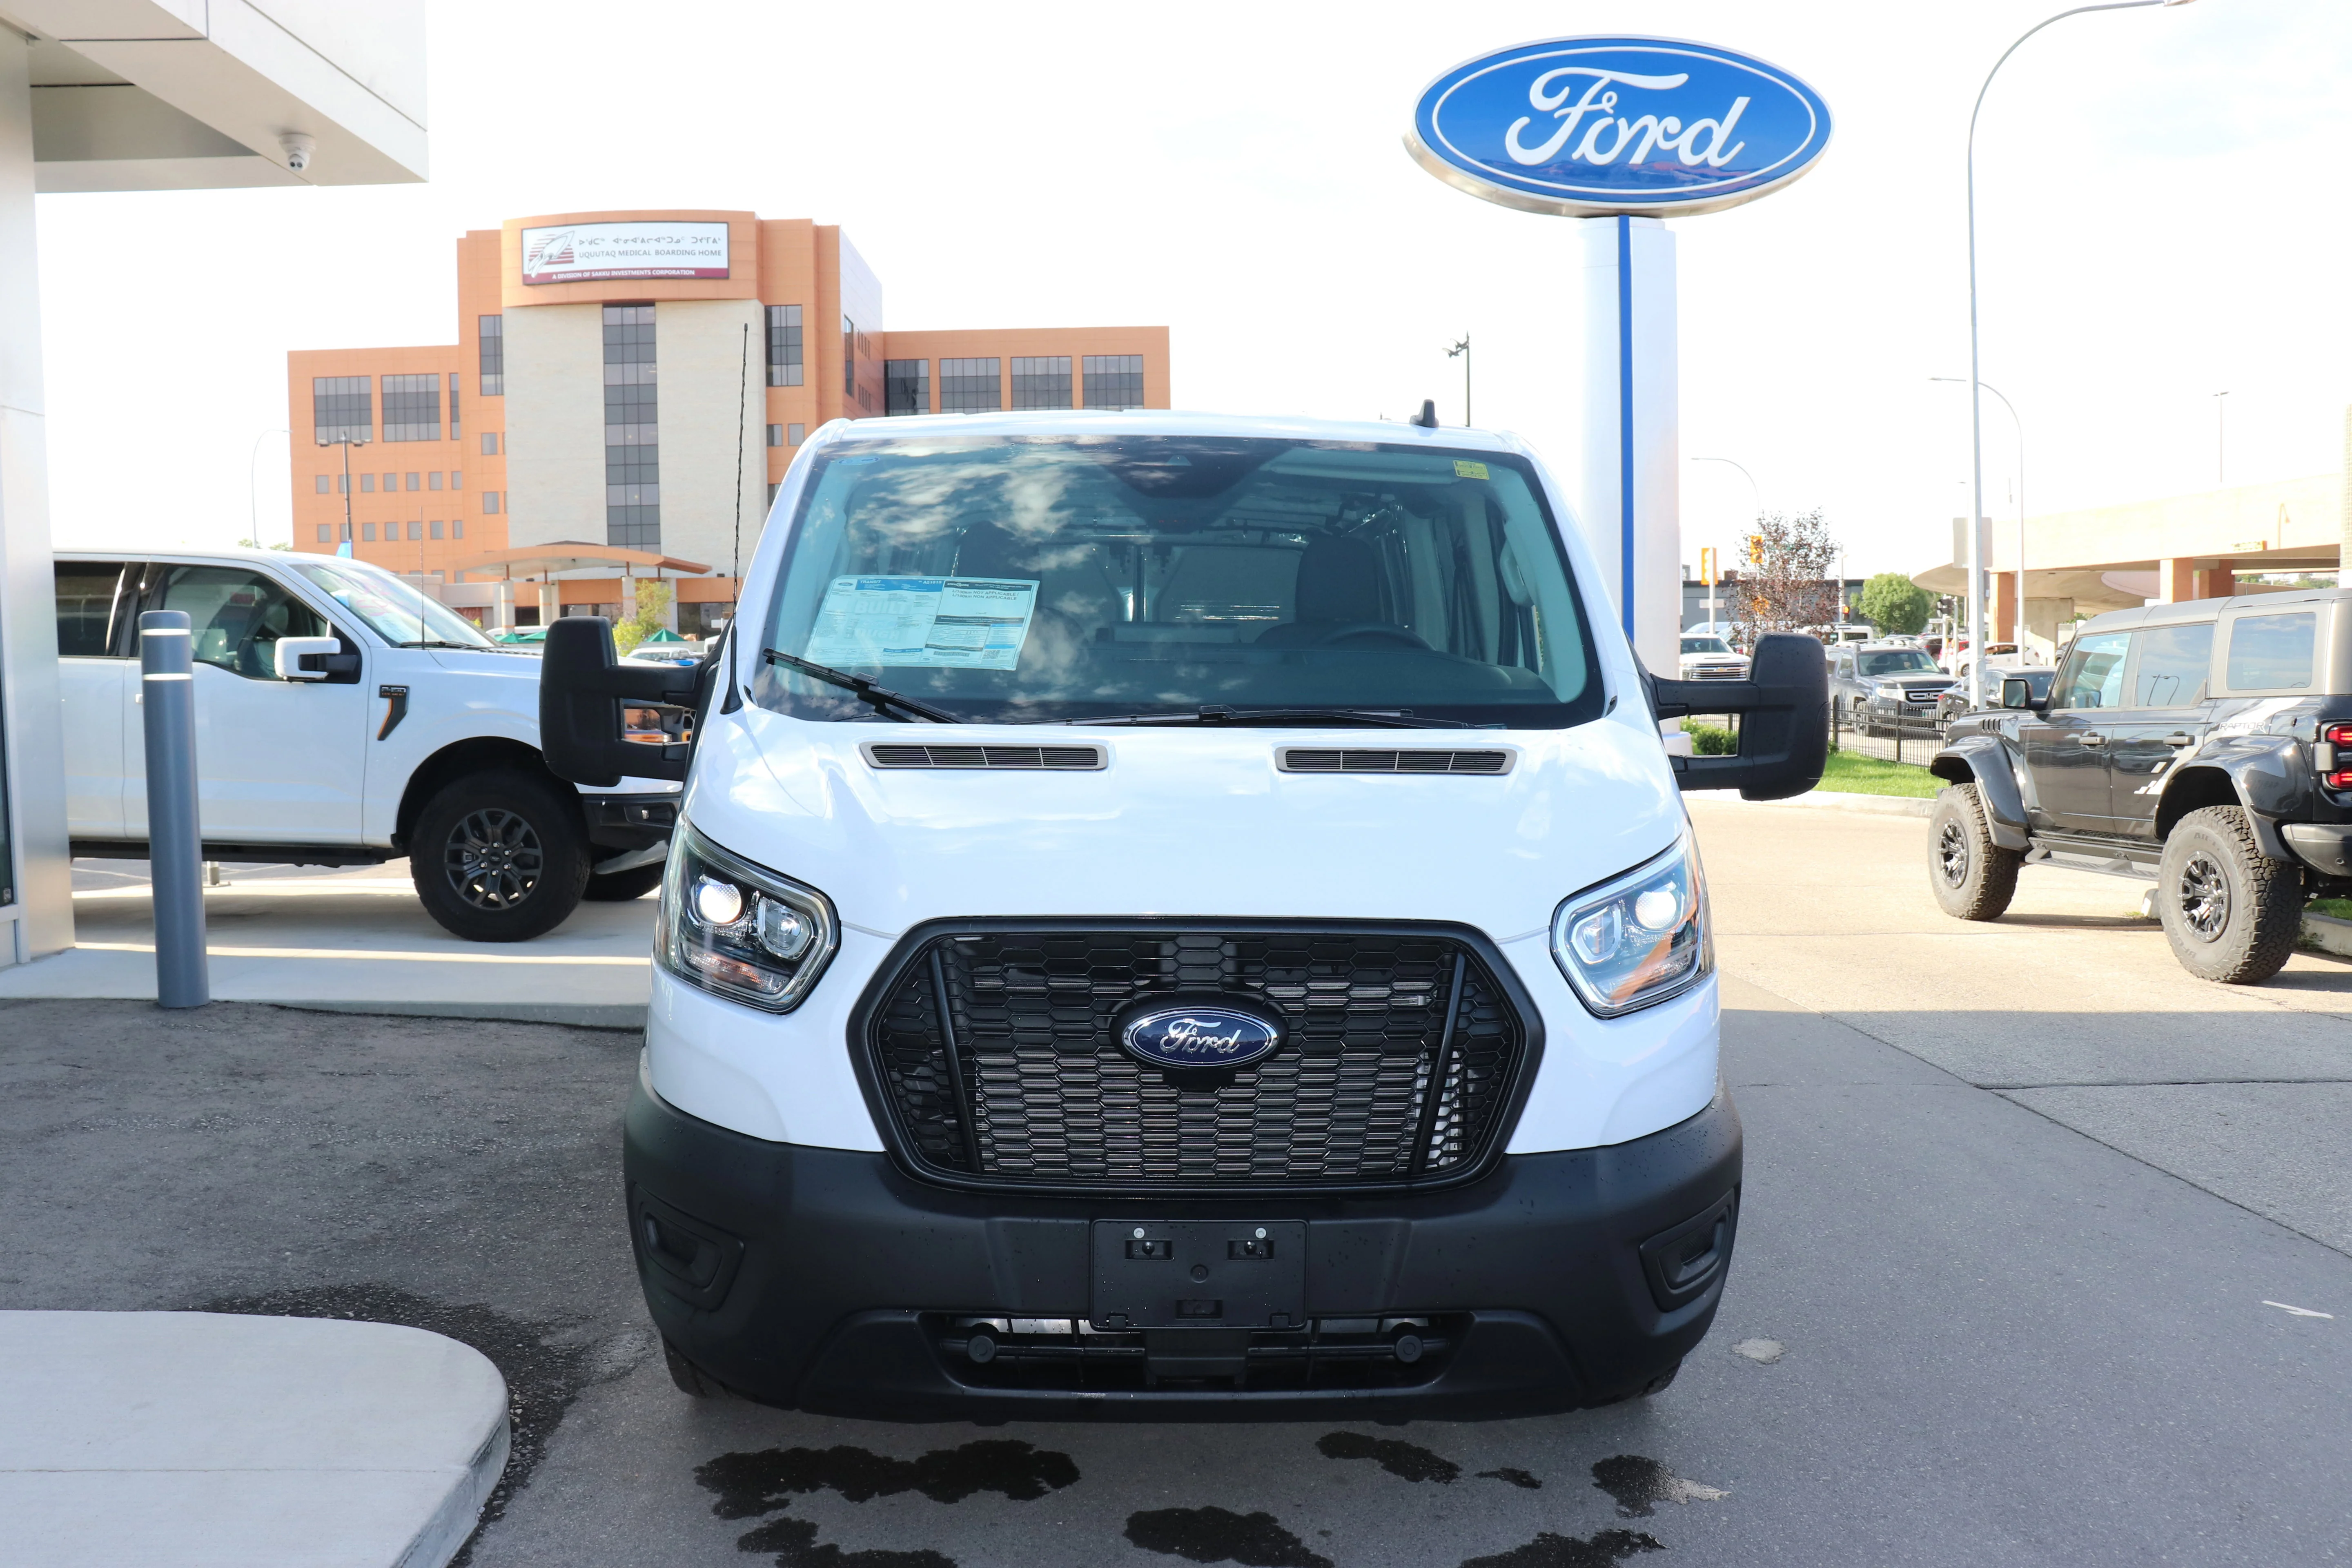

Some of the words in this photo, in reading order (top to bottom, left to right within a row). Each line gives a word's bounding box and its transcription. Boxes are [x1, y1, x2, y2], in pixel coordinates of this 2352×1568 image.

[1506, 66, 1751, 167] Ford
[579, 250, 616, 258] UQUUTAQ
[2220, 722, 2266, 733] RAPTOR
[1159, 1018, 1242, 1054] Ford
